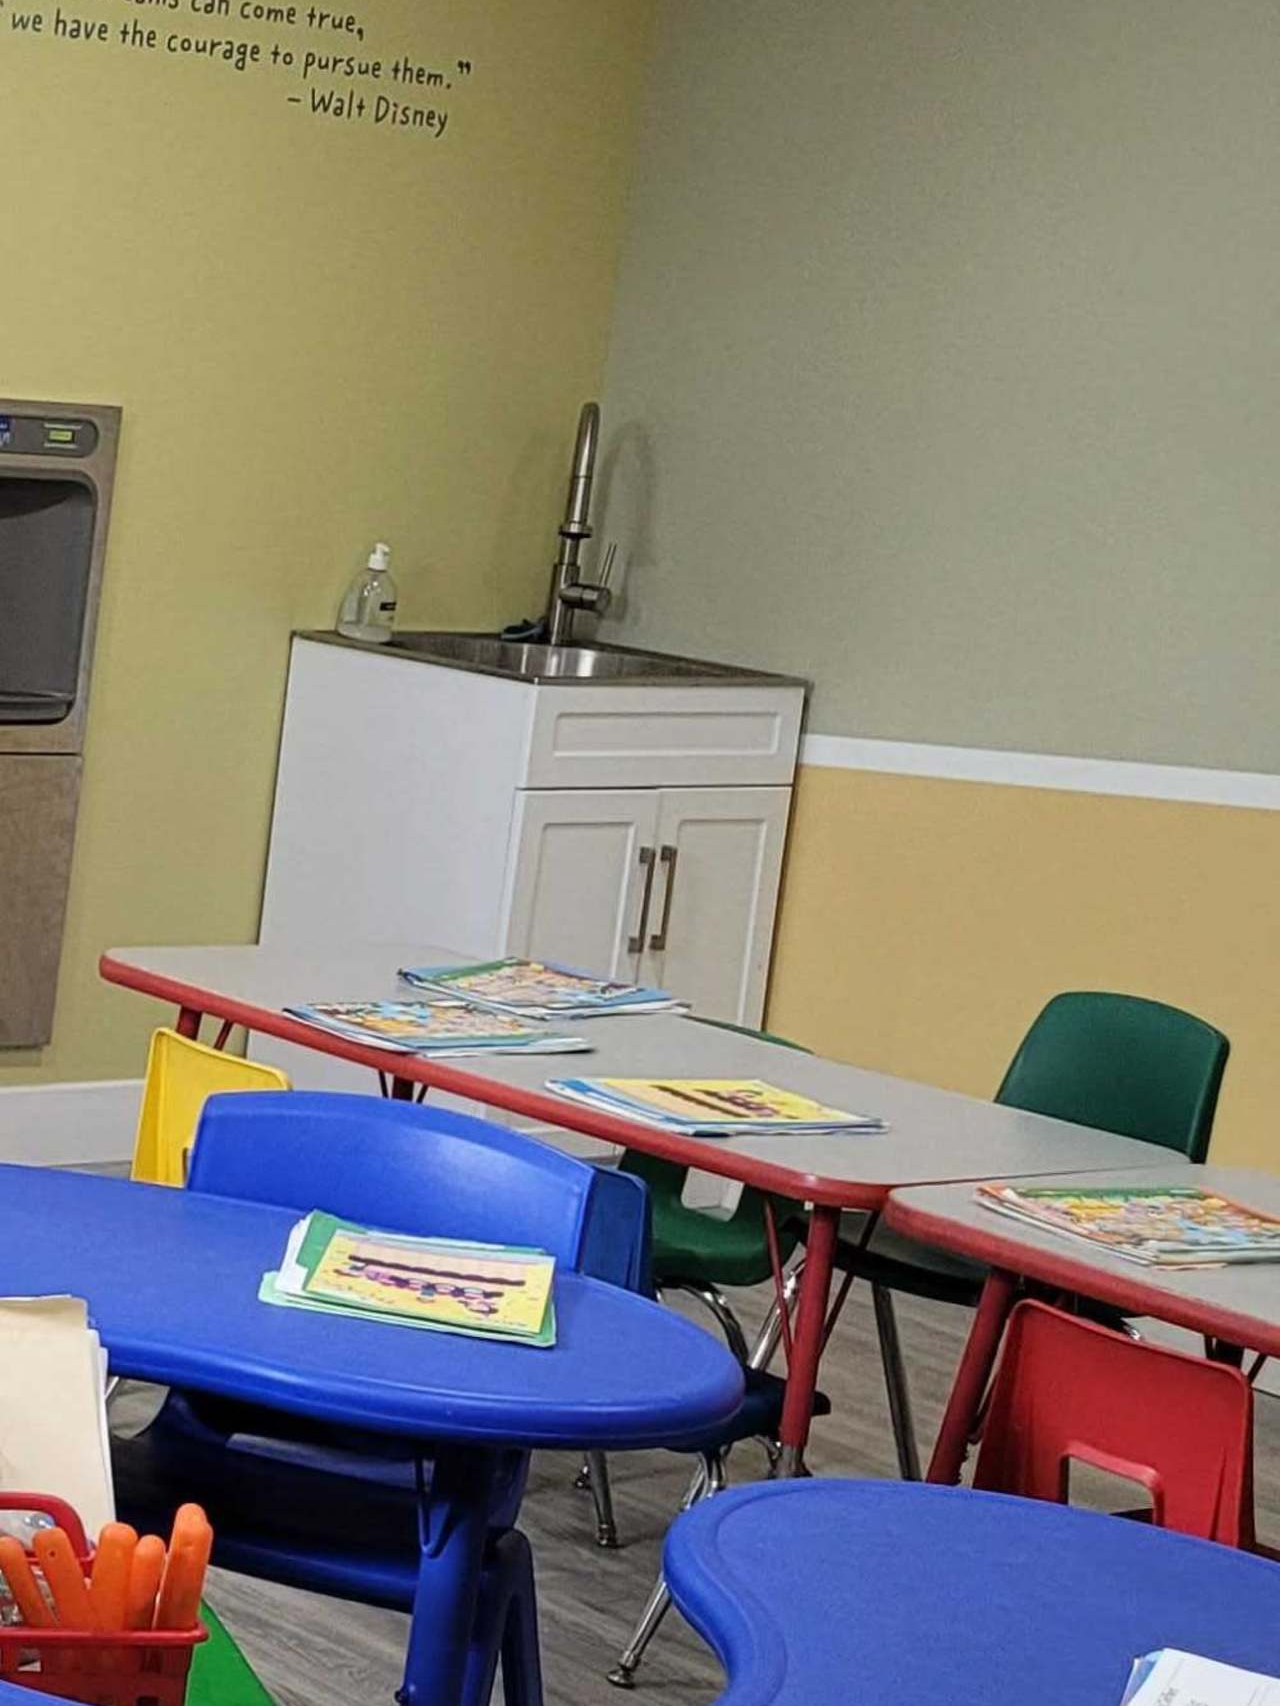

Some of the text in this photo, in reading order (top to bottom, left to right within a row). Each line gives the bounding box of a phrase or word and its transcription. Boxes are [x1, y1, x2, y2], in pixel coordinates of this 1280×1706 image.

[11, 13, 43, 33] we
[54, 8, 108, 42] have
[120, 19, 157, 48] the
[166, 33, 261, 70] courage
[271, 43, 294, 66] to
[304, 51, 381, 79] pursue
[240, 0, 296, 24] come
[306, 5, 365, 42] true,
[311, 88, 366, 119] Walt
[374, 92, 449, 137] Disney
